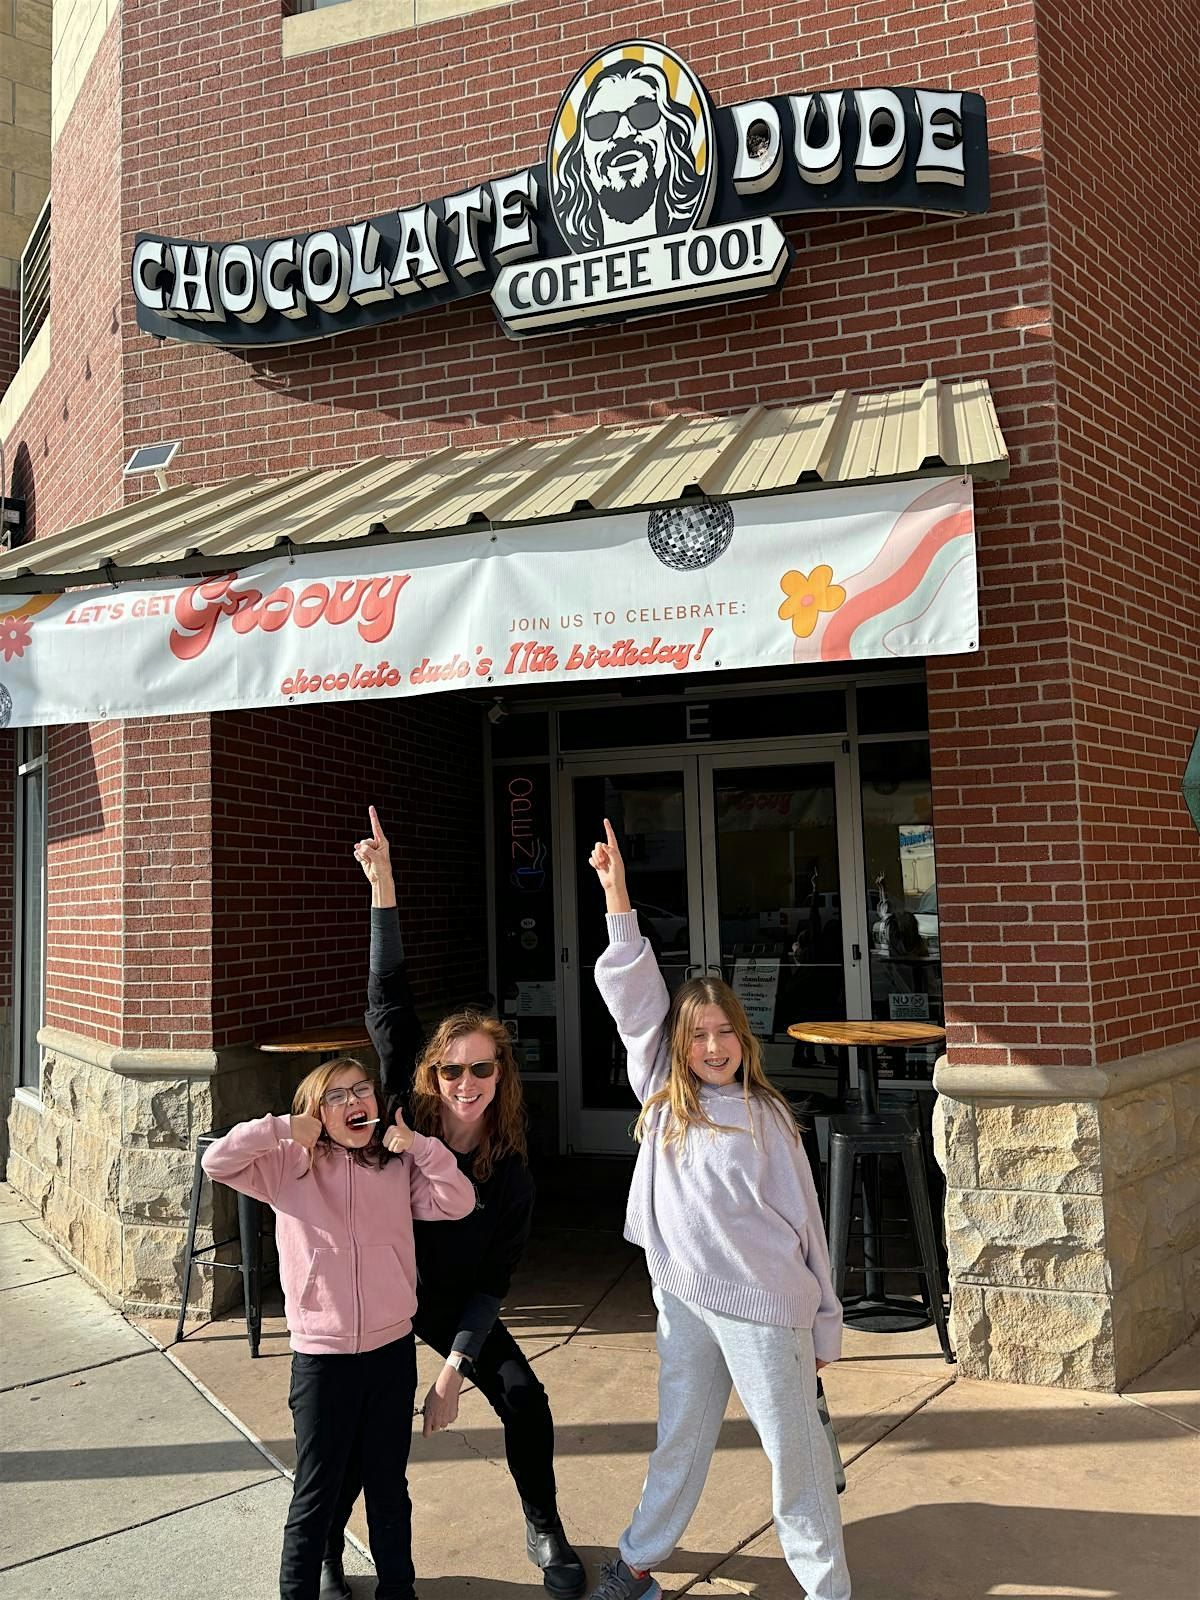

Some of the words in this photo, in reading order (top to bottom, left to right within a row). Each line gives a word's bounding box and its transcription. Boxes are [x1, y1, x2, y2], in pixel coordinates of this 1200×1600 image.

[132, 170, 538, 318] CHOCOLATE
[731, 87, 967, 191] DUDE
[508, 245, 652, 310] COFFEE
[663, 223, 764, 279] TOO!
[65, 602, 125, 625] LET'S
[131, 594, 175, 617] GET
[169, 571, 412, 660] Groovy
[509, 616, 550, 632] JOIN
[560, 614, 583, 629] US
[593, 611, 616, 625] TO
[626, 601, 746, 623] CELEBRATE:
[280, 660, 402, 695] chocolate
[409, 645, 493, 684] dude's
[503, 640, 559, 674] 11th
[565, 627, 714, 671] birthday!
[686, 704, 711, 739] E
[508, 777, 535, 859] OPEN
